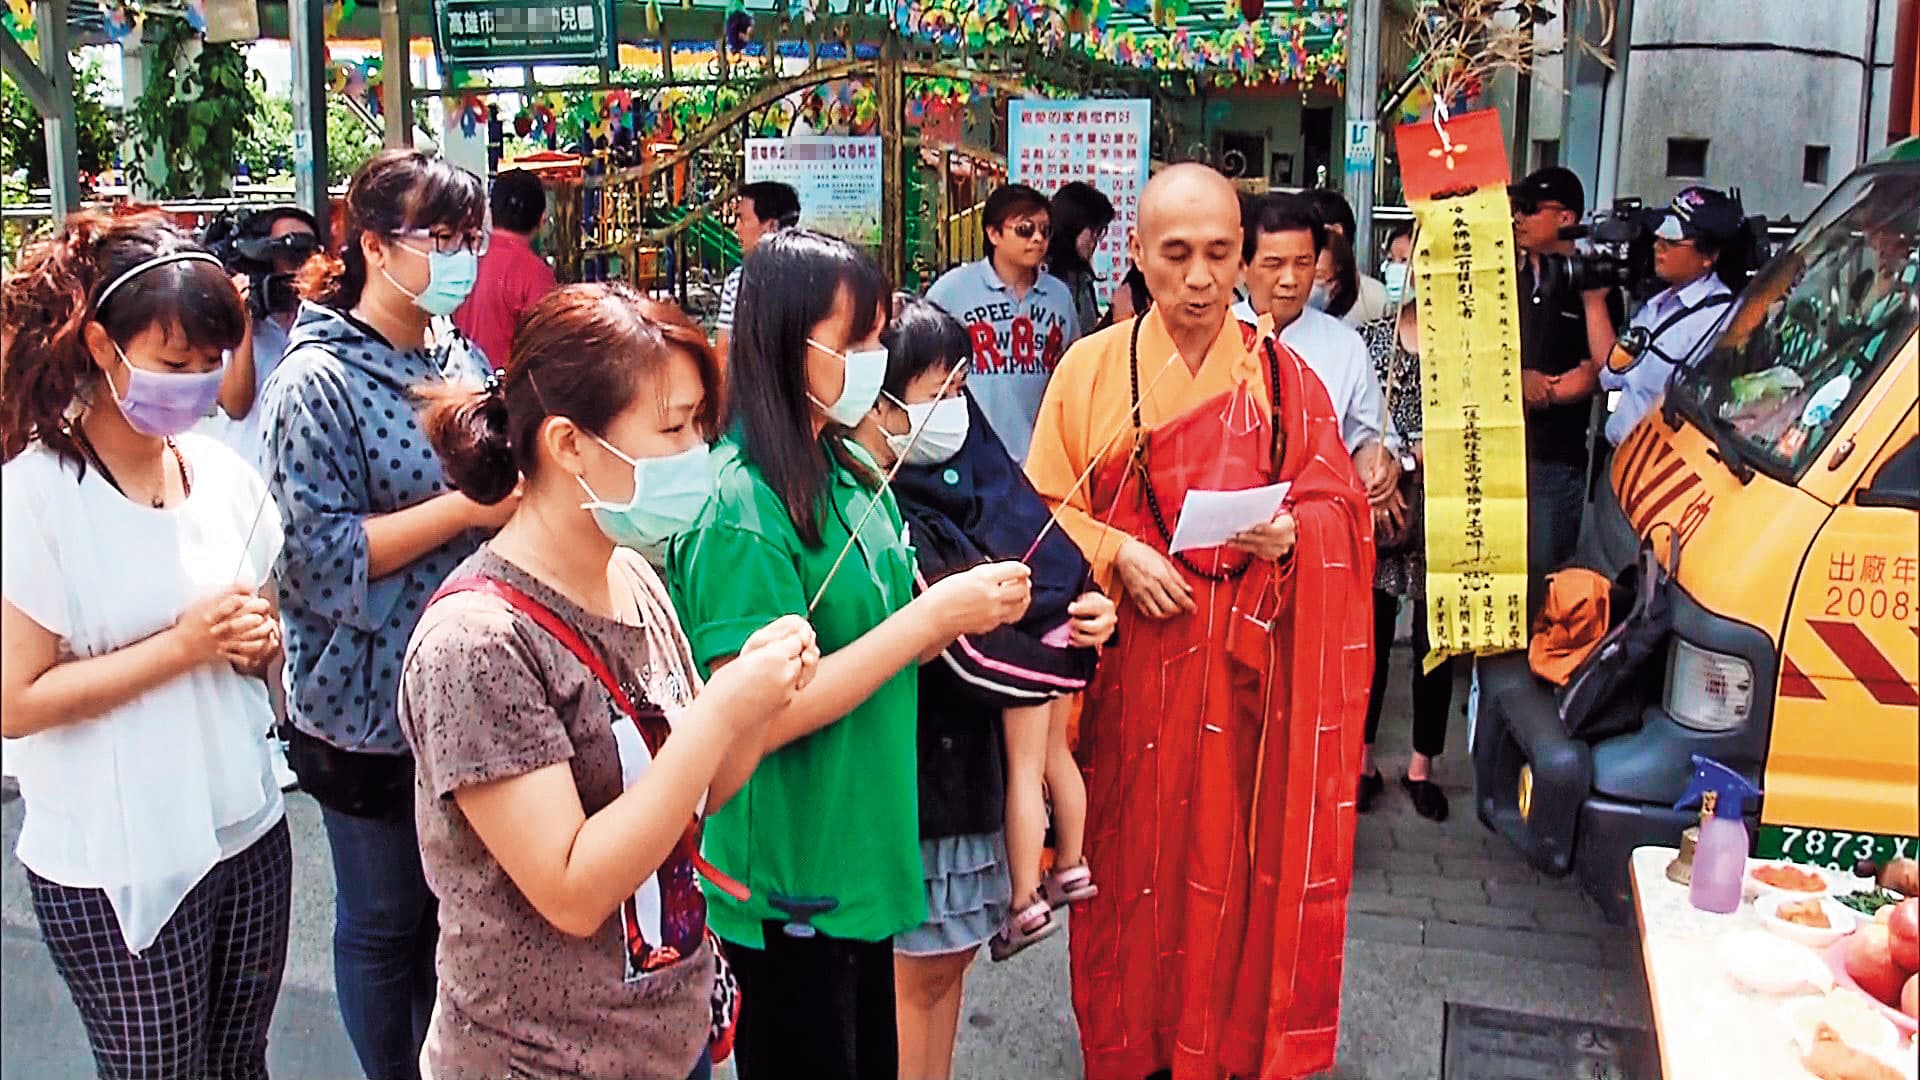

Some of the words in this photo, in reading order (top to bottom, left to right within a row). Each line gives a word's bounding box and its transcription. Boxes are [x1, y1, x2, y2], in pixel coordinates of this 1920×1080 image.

[1828, 551, 1917, 584] 出廠年
[1781, 827, 1919, 860] 7873-X
